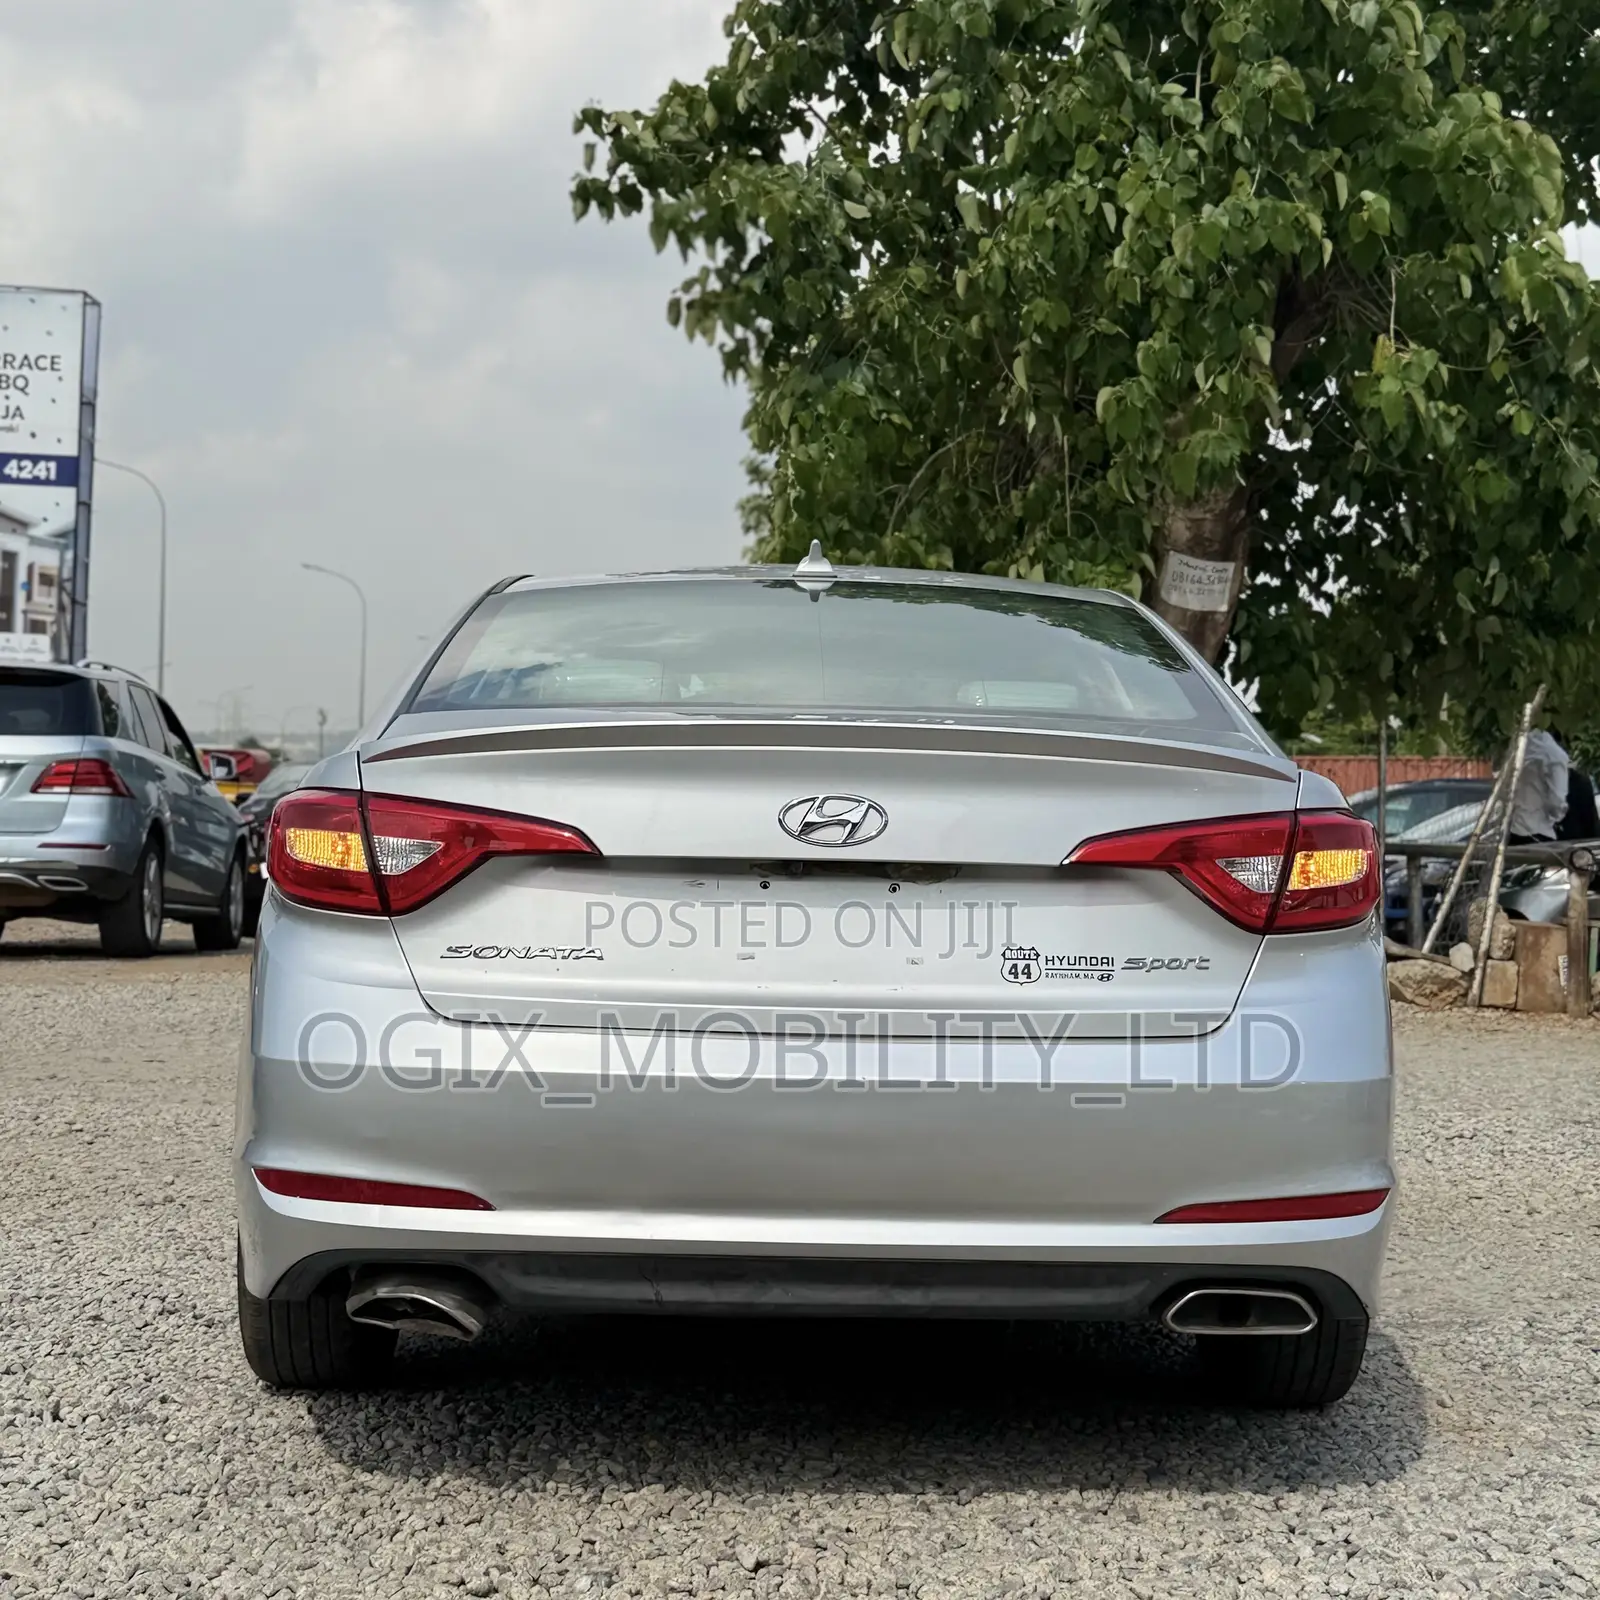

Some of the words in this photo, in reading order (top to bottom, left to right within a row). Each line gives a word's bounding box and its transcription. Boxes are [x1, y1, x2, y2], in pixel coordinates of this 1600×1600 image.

[0, 353, 62, 372] RACE
[3, 459, 57, 481] 4241
[440, 945, 604, 961] SONATA
[1005, 950, 1037, 959] ROUTE
[1045, 955, 1114, 967] HYUNDAI
[1008, 963, 1032, 979] 44
